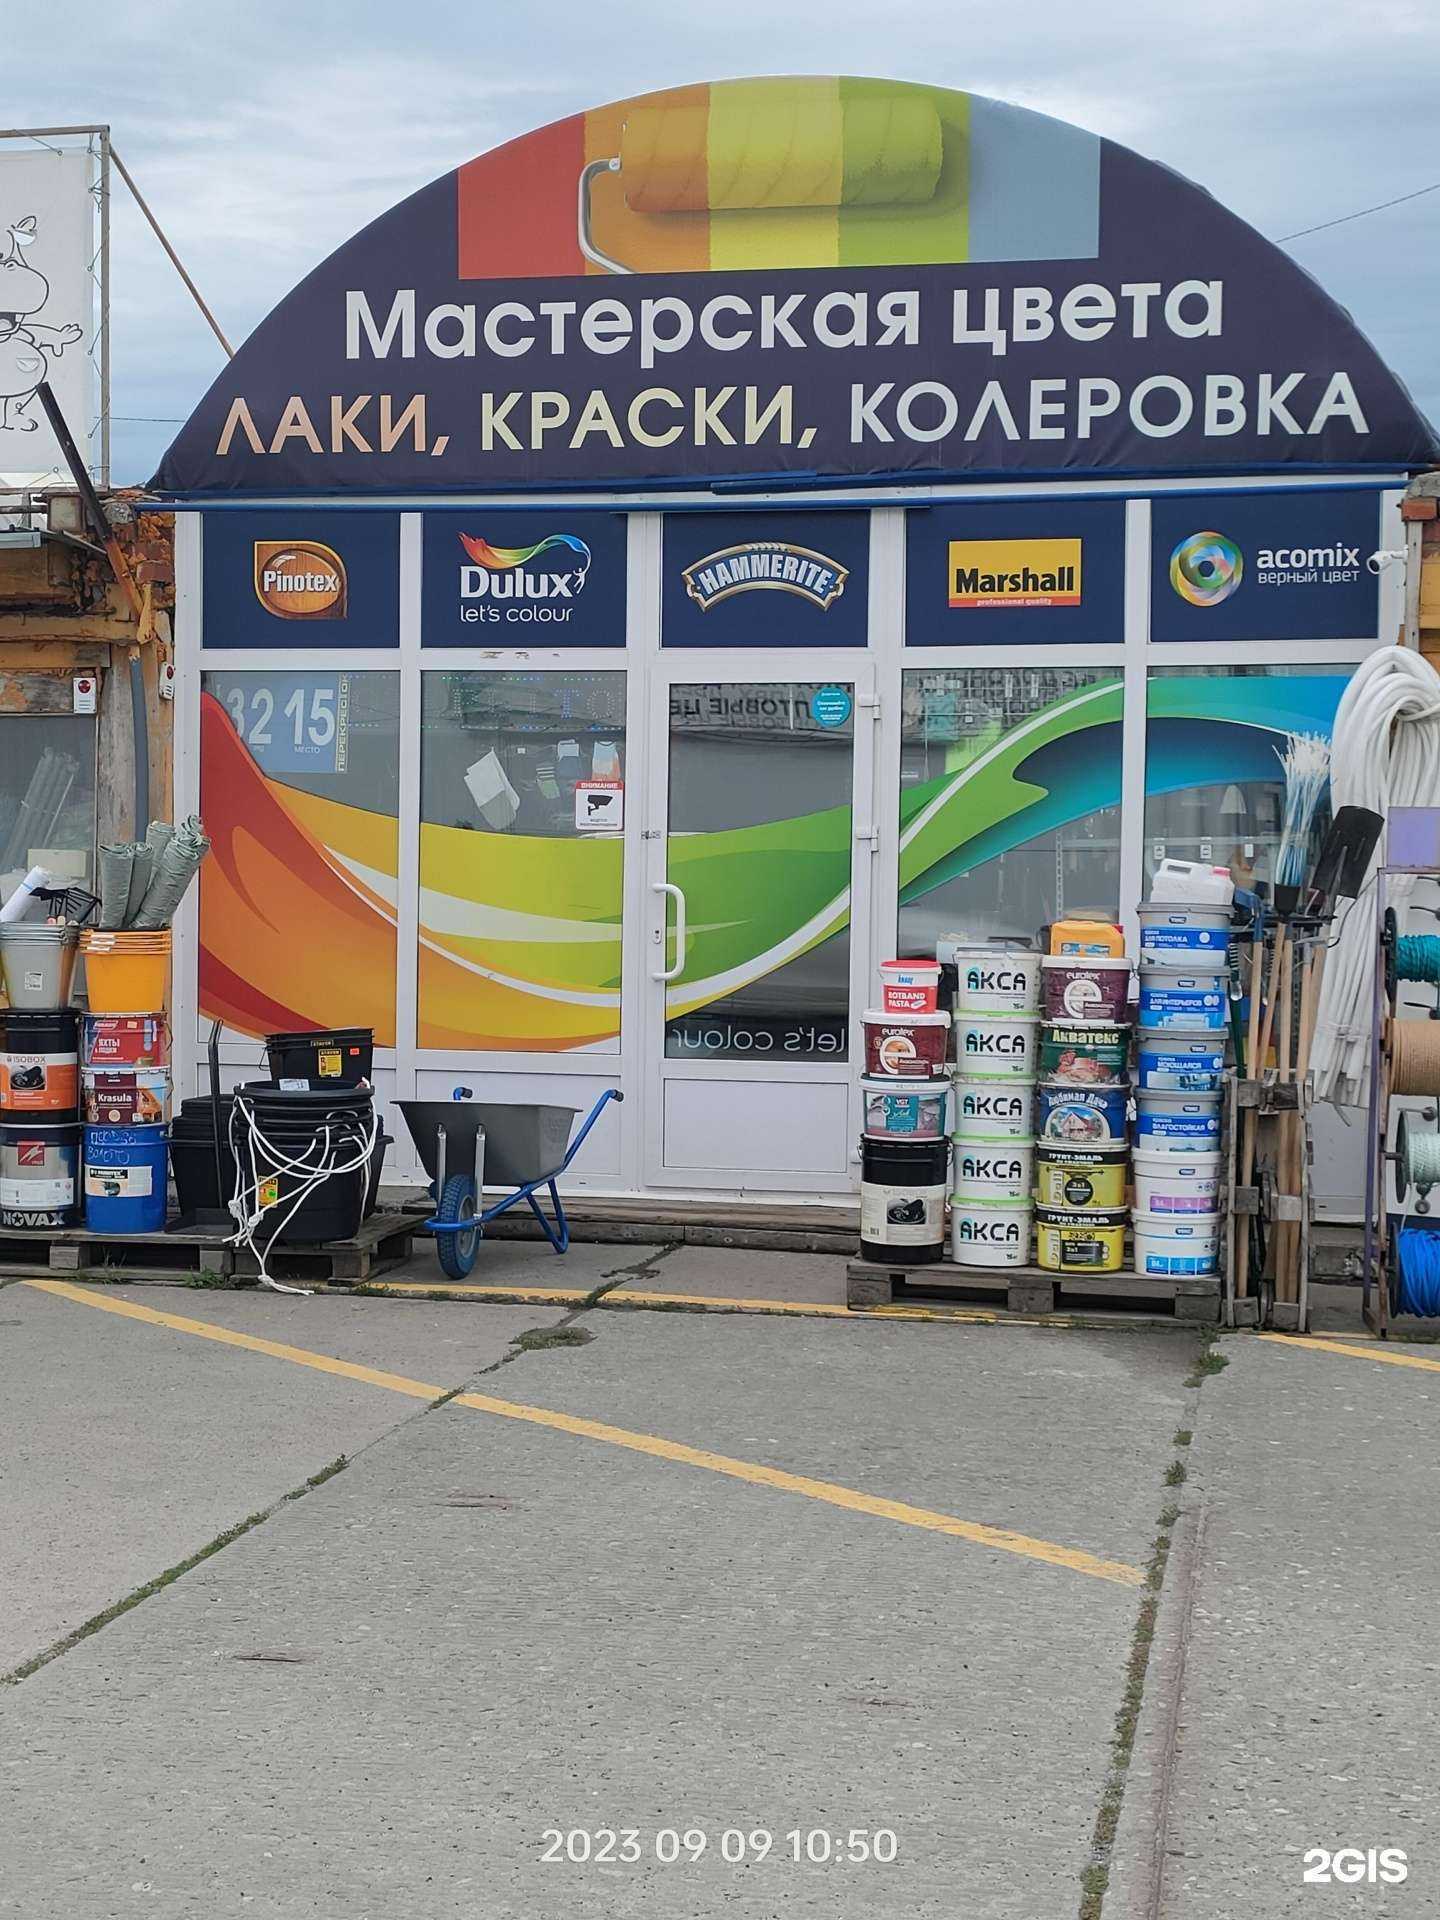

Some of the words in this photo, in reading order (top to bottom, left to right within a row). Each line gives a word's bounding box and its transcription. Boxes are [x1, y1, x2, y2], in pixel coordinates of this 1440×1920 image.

[346, 289, 919, 369] Мастерская
[952, 280, 1223, 355] цвета
[216, 394, 449, 456] ЛАКИ,
[481, 384, 818, 451] КРАСКИ,
[850, 372, 1370, 443] КОЛЕРОВКА
[1256, 542, 1360, 569] acomix
[263, 570, 338, 593] Pinotex
[460, 566, 573, 599] Dulux
[698, 554, 835, 596] HAMMERITE
[955, 566, 1074, 594] Marshall
[1258, 569, 1318, 586] верный
[1322, 569, 1361, 584] цвет
[460, 604, 500, 623] let's
[506, 604, 574, 623] colour
[977, 598, 1025, 607] professional
[1025, 597, 1053, 606] quality
[226, 688, 274, 745] 32
[284, 688, 336, 746] 15
[294, 745, 321, 754] МЕСТО
[1052, 1029, 1120, 1044] Акватекс
[97, 1093, 132, 1103] Krasula
[2, 1211, 65, 1227] NOVAX
